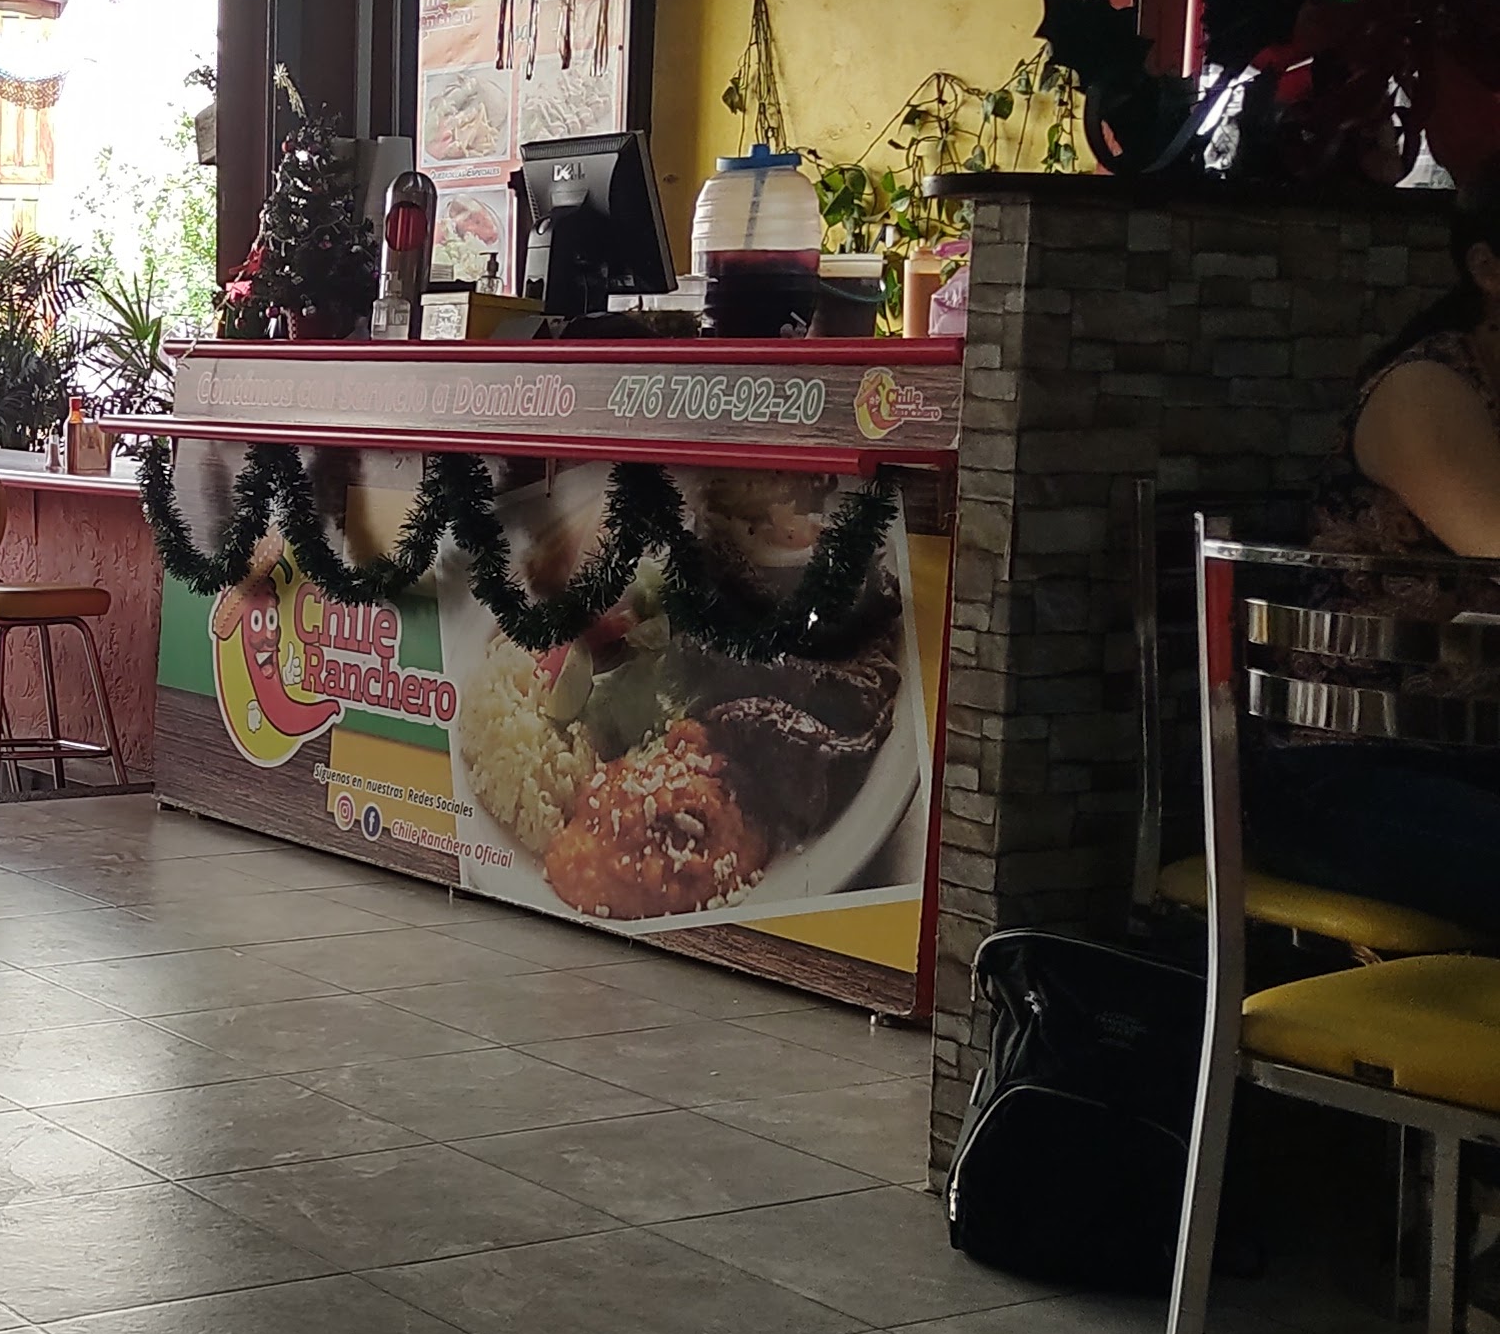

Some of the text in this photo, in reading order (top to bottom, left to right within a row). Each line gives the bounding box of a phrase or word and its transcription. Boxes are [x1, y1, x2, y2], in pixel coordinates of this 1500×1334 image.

[299, 377, 334, 409] con
[340, 373, 428, 412] Servicio
[432, 382, 449, 414] a
[453, 373, 576, 418] Domicilio
[608, 375, 663, 418] 476
[667, 375, 826, 425] 706-92-20
[886, 388, 922, 406] Chile
[294, 581, 398, 659] Chile
[301, 643, 457, 722] Ranchero
[314, 763, 475, 818] Síguenos en nuestras Redes Sociales
[391, 820, 515, 869] Chile Ranchero Oficial
